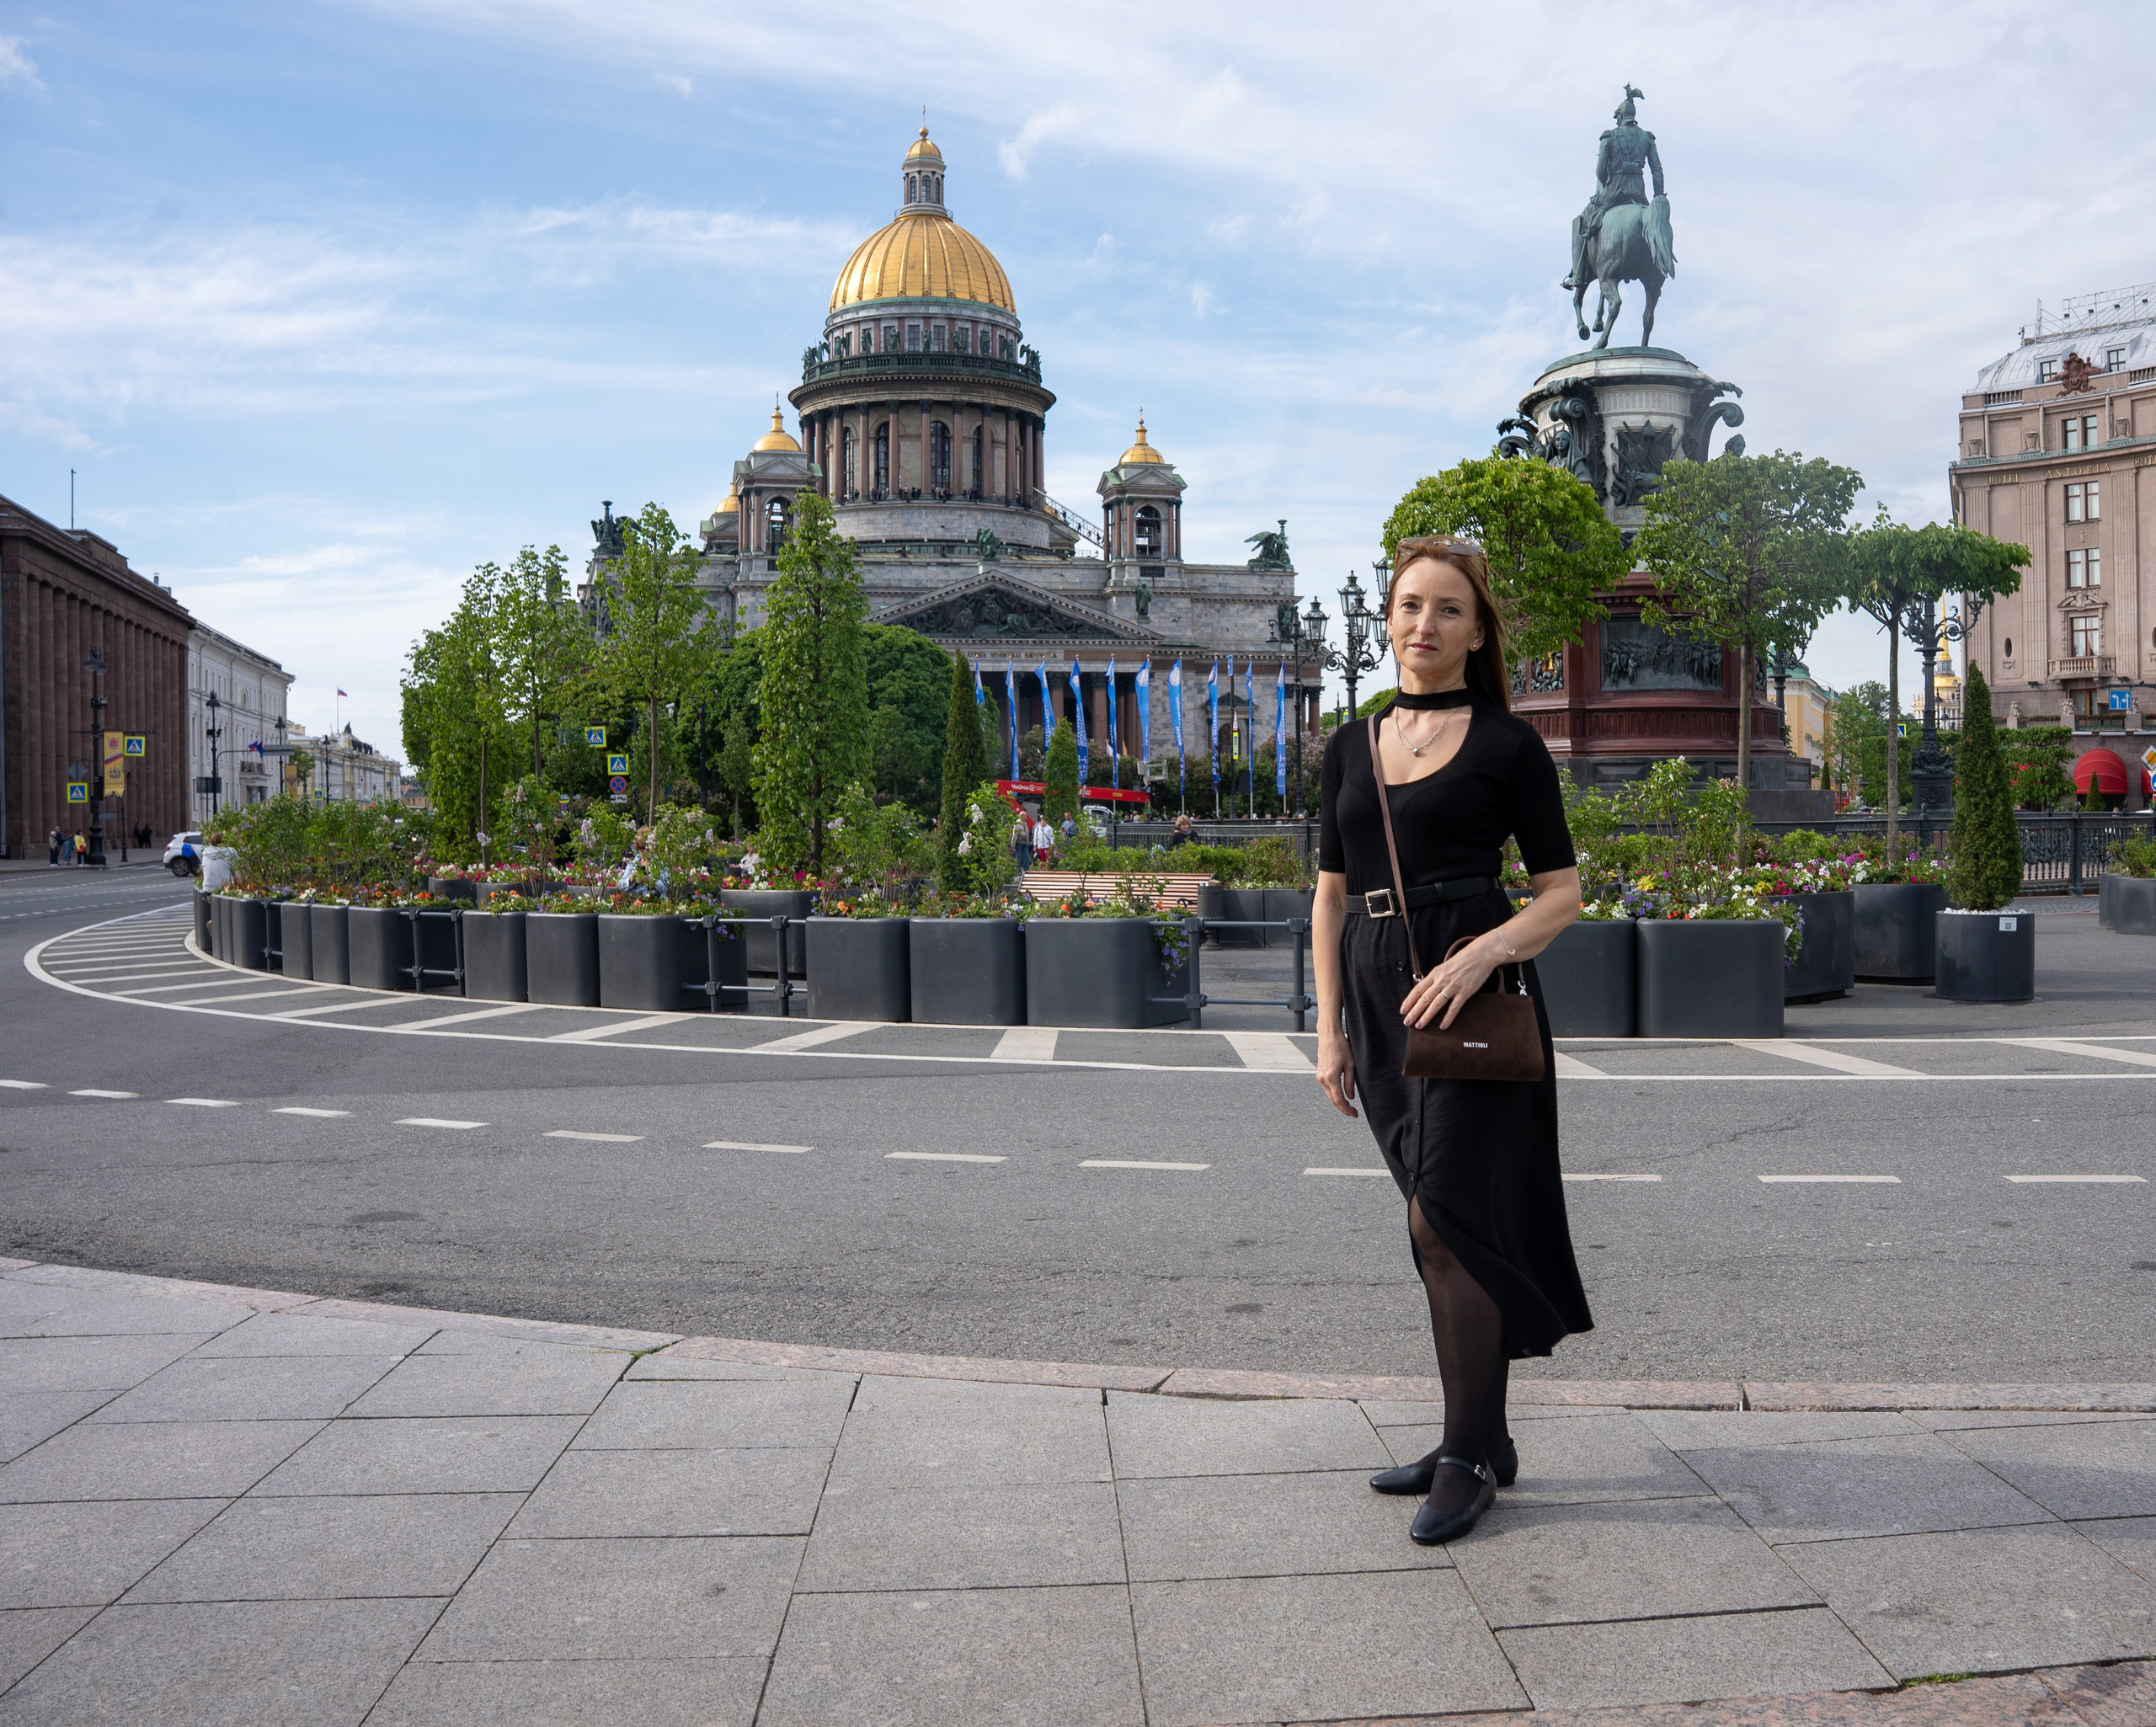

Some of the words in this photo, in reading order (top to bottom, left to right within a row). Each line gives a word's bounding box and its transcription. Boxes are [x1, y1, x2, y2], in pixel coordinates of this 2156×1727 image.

[2134, 455, 2156, 467] HOT
[1988, 473, 2020, 484] HOTEL
[2047, 462, 2111, 479] ASTORIA
